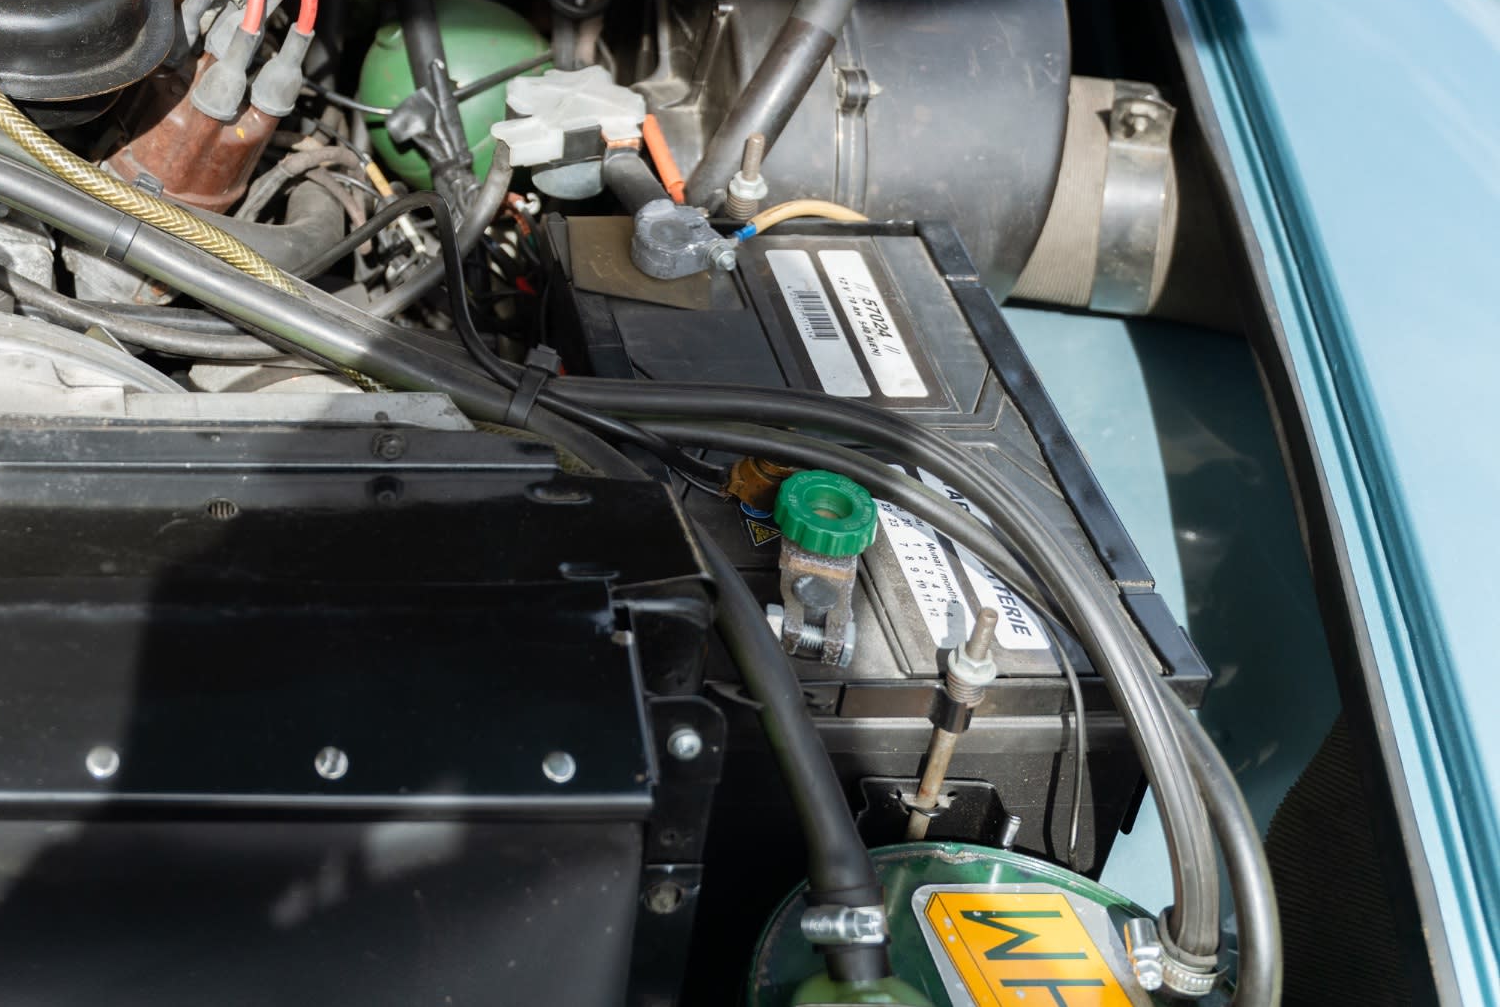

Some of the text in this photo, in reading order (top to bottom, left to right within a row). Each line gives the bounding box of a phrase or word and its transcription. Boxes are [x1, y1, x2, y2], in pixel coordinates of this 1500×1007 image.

[862, 297, 893, 339] 57024
[916, 579, 927, 590] 10
[922, 593, 933, 603] 11
[928, 608, 940, 618] 12
[931, 582, 941, 590] 4
